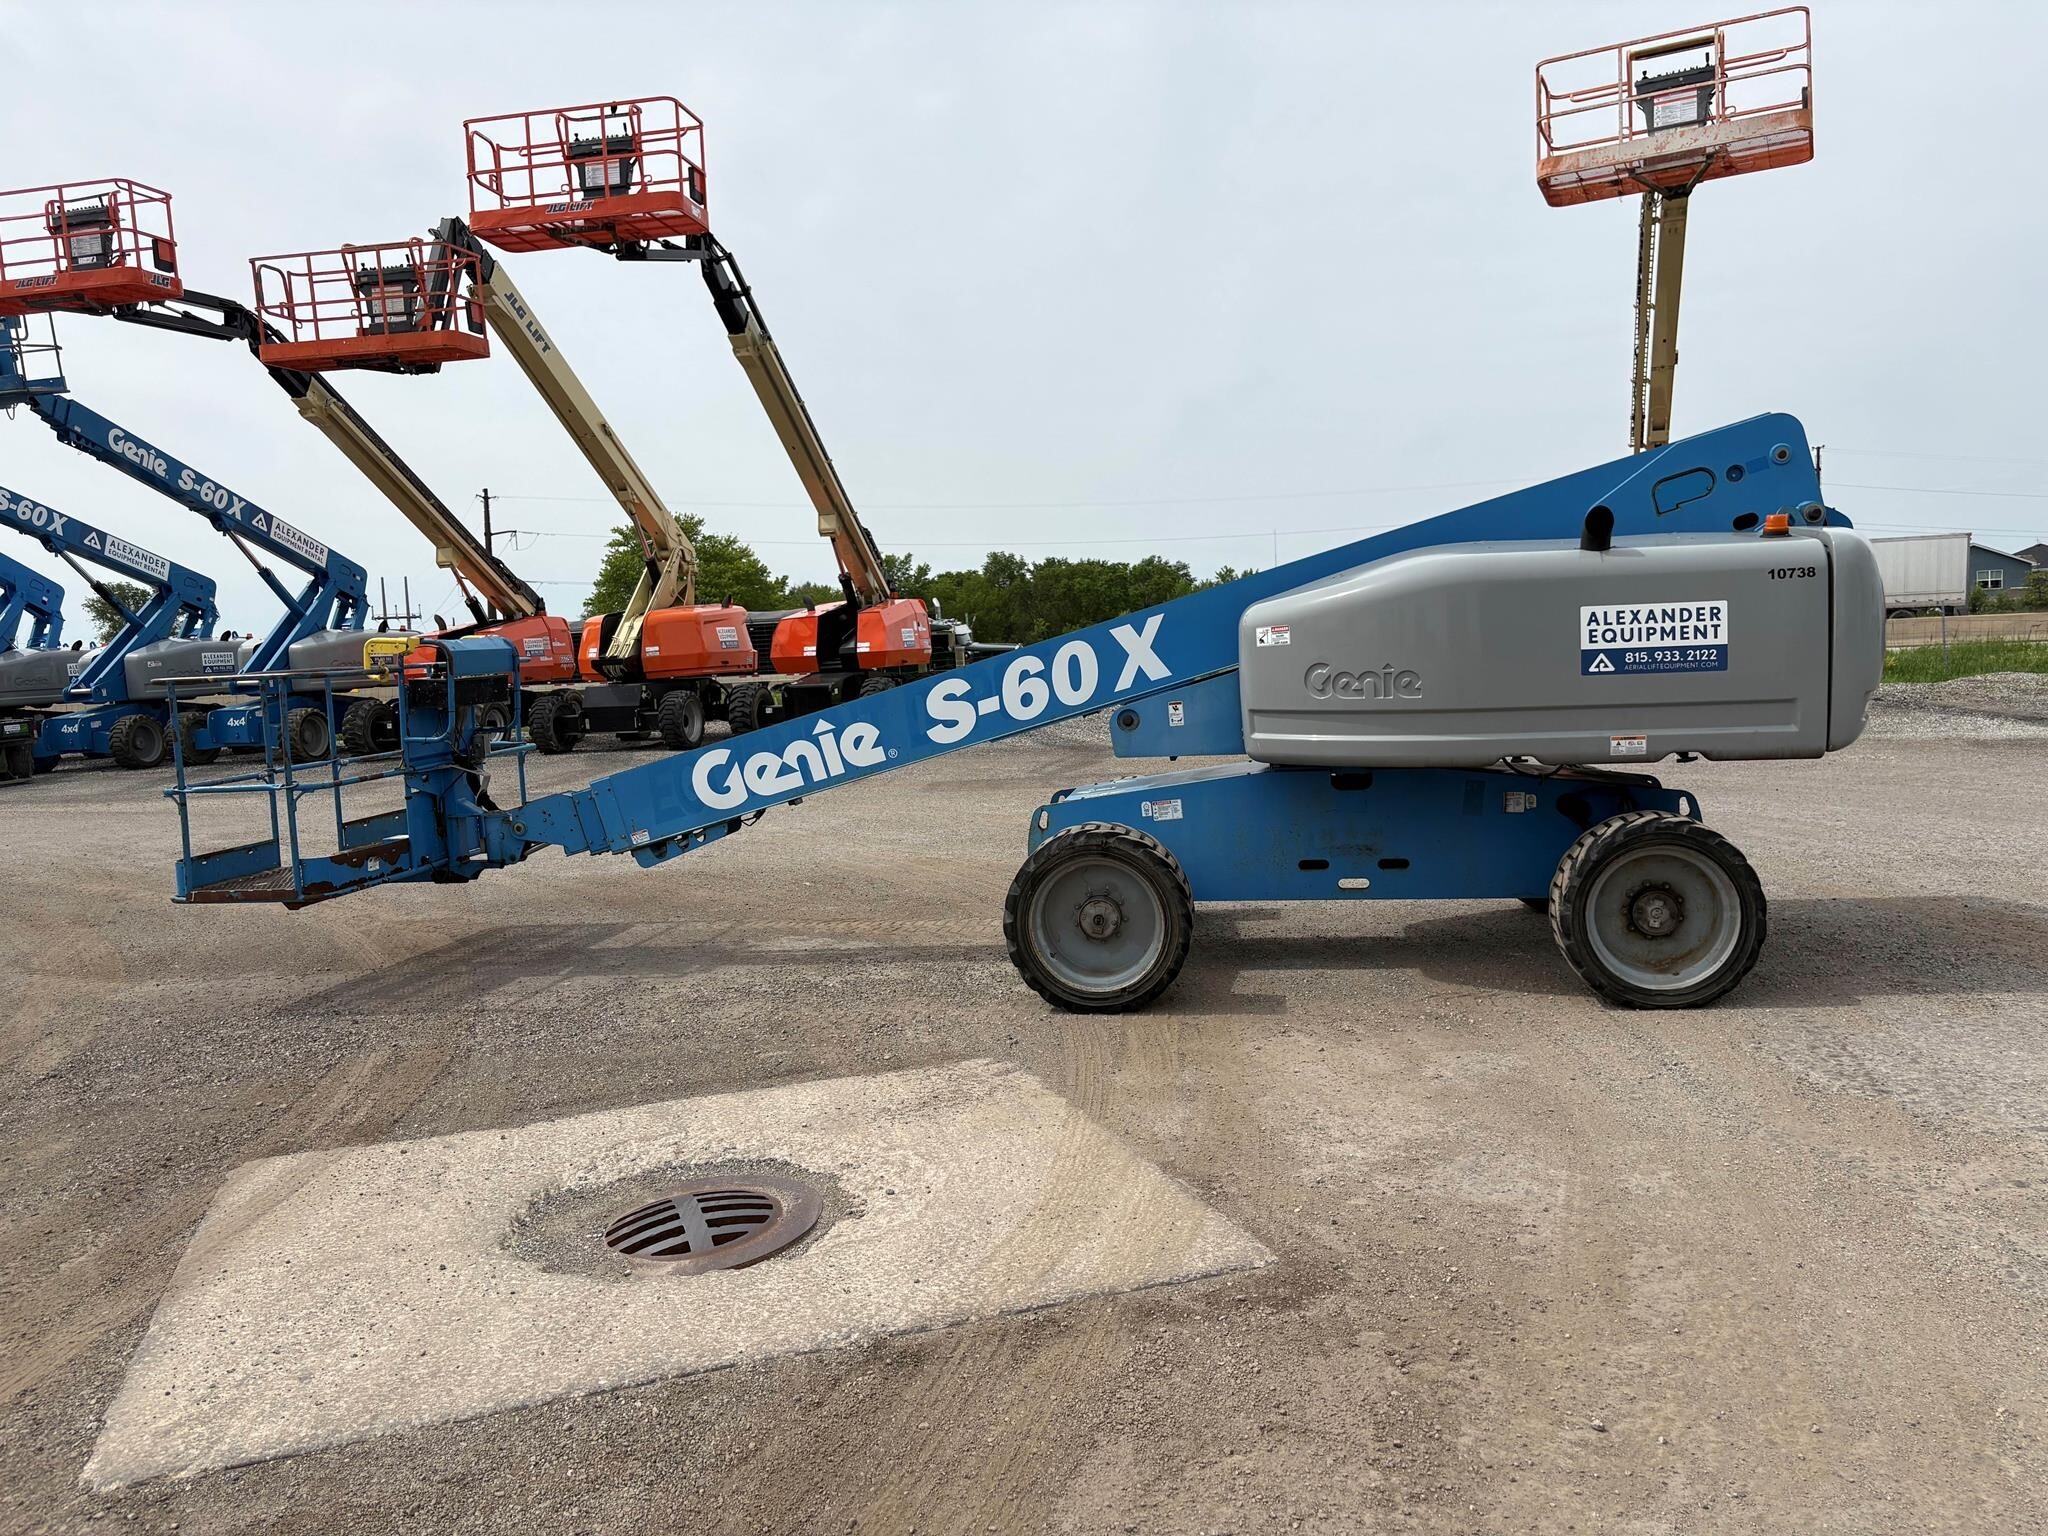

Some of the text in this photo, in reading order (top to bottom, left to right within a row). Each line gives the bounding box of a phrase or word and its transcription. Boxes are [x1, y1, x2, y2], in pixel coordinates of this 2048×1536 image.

[545, 200, 594, 213] JLG LIFT
[15, 275, 58, 289] JLG LIFT
[150, 274, 170, 288] JLG
[504, 292, 551, 353] JLG LIFT
[108, 428, 167, 477] Genie
[273, 531, 324, 564] EQUIPMENT RENTAL
[275, 522, 325, 557] ALEXANDER
[108, 548, 165, 577] EQUIPMENT RENTAL
[110, 539, 166, 570] ALEXANDER
[1767, 566, 1816, 580] 10738
[1586, 606, 1722, 627] ALEXANDER
[1588, 624, 1721, 644] EQUIPMENT
[1304, 662, 1422, 699] Genie
[61, 723, 79, 734] 4x4
[226, 716, 246, 727] 4x4
[692, 718, 887, 810] Genie
